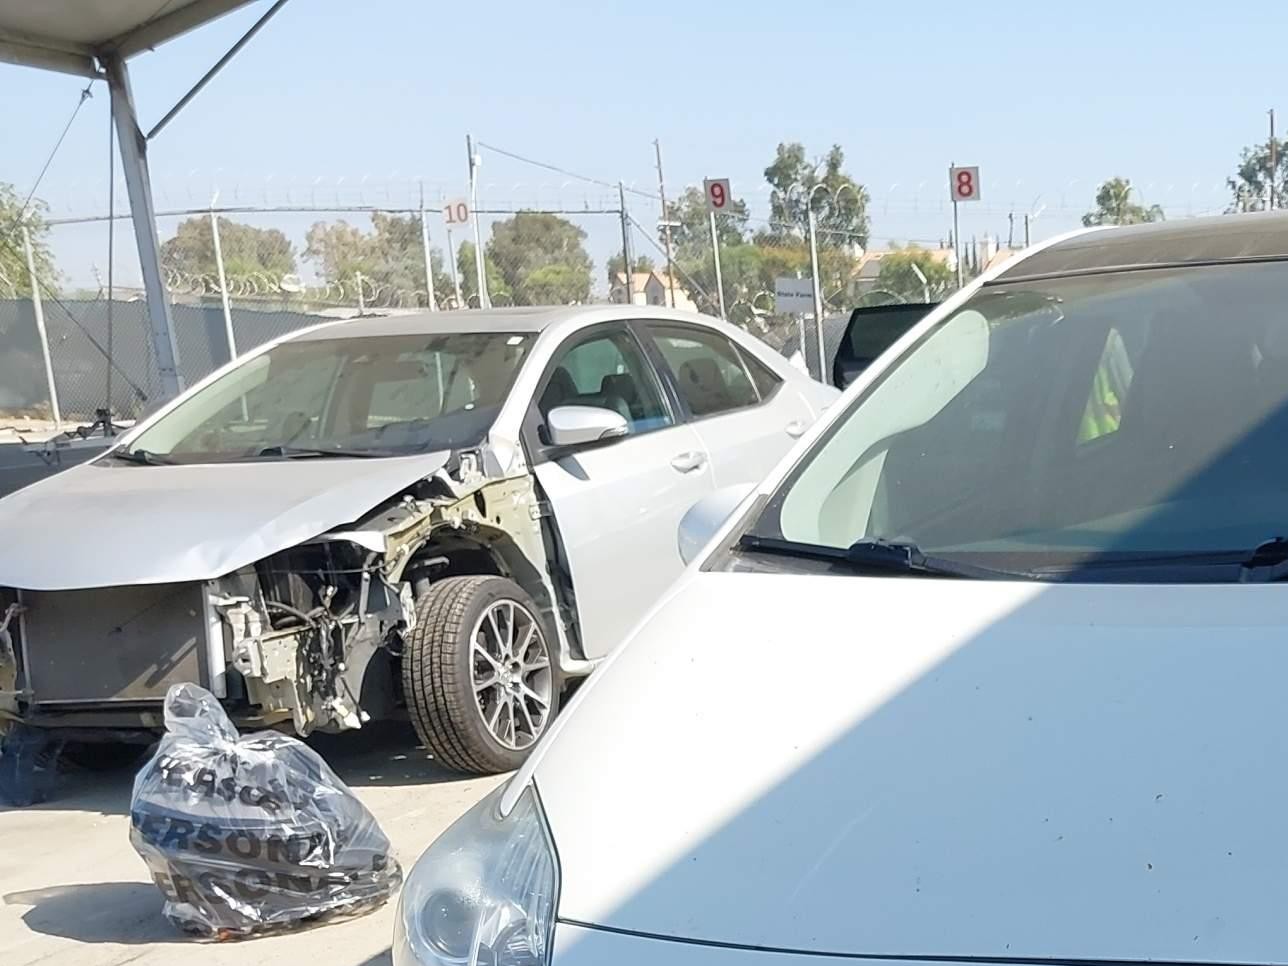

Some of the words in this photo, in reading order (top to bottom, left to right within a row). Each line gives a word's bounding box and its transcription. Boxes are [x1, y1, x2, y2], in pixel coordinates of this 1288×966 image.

[710, 182, 726, 209] 9
[957, 170, 973, 198] 8
[443, 202, 468, 224] 10
